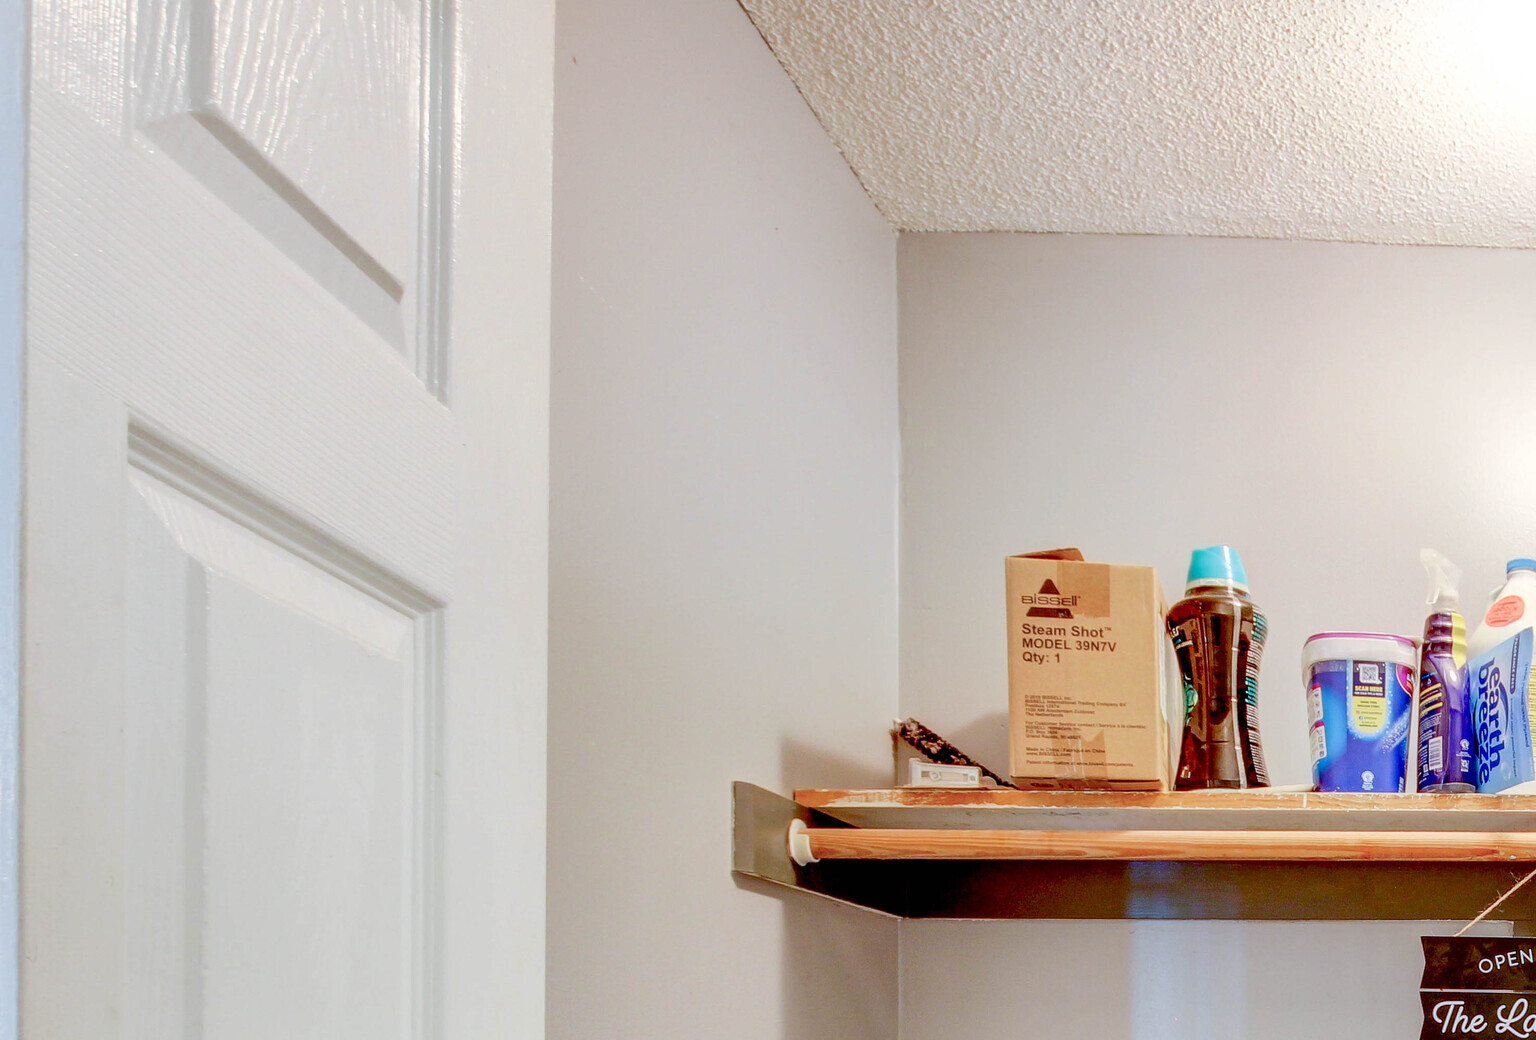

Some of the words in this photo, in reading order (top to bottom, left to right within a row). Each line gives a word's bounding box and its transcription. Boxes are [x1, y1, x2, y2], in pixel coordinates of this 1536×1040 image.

[1022, 623, 1066, 636] Steam
[1022, 638, 1072, 650] MODEL
[1075, 640, 1117, 652] 39N7V
[1022, 651, 1050, 665] Qty:
[1054, 652, 1061, 663] 1
[1479, 657, 1496, 785] breeze
[1488, 666, 1505, 772] earth
[1478, 948, 1534, 974] OPEN
[1432, 1000, 1488, 1034] The
